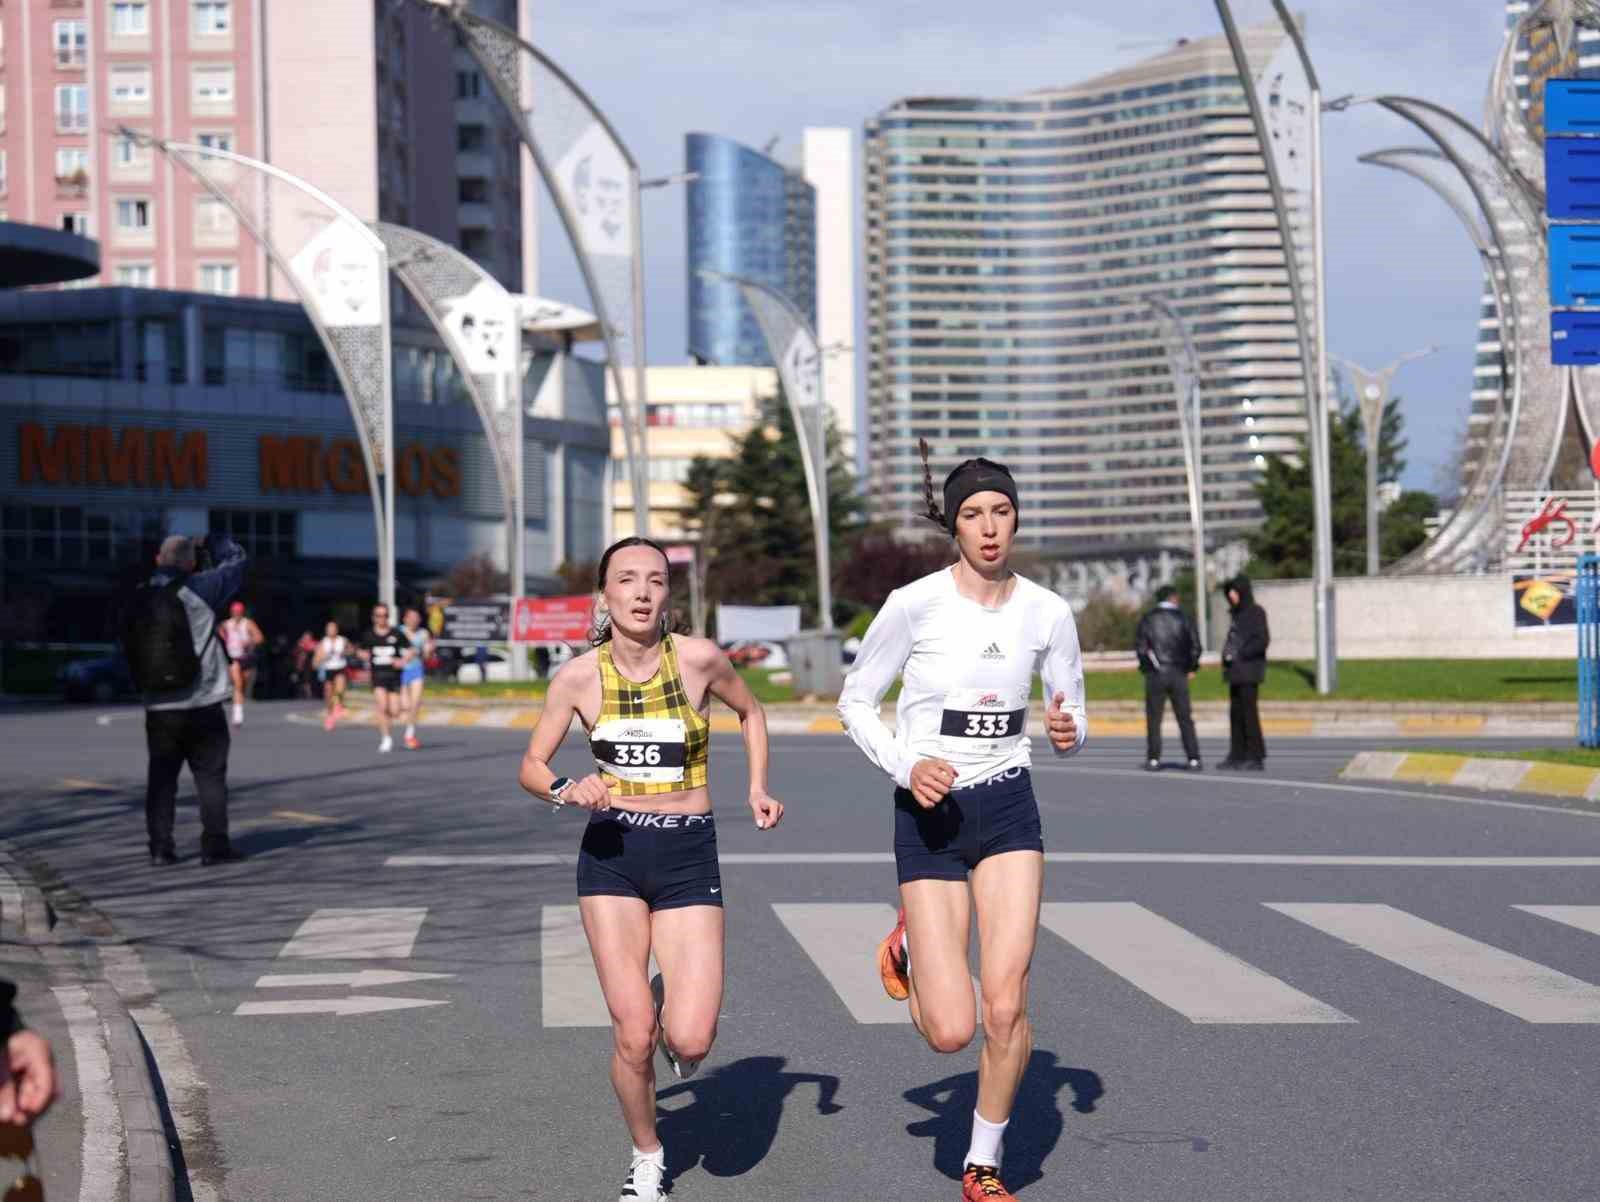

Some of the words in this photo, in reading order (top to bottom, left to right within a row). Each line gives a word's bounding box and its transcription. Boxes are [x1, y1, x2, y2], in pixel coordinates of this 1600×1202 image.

[18, 423, 208, 490] MMM
[257, 433, 462, 497] MiGOS
[964, 714, 1010, 736] 333
[614, 744, 661, 765] 336
[616, 812, 681, 828] NIKE
